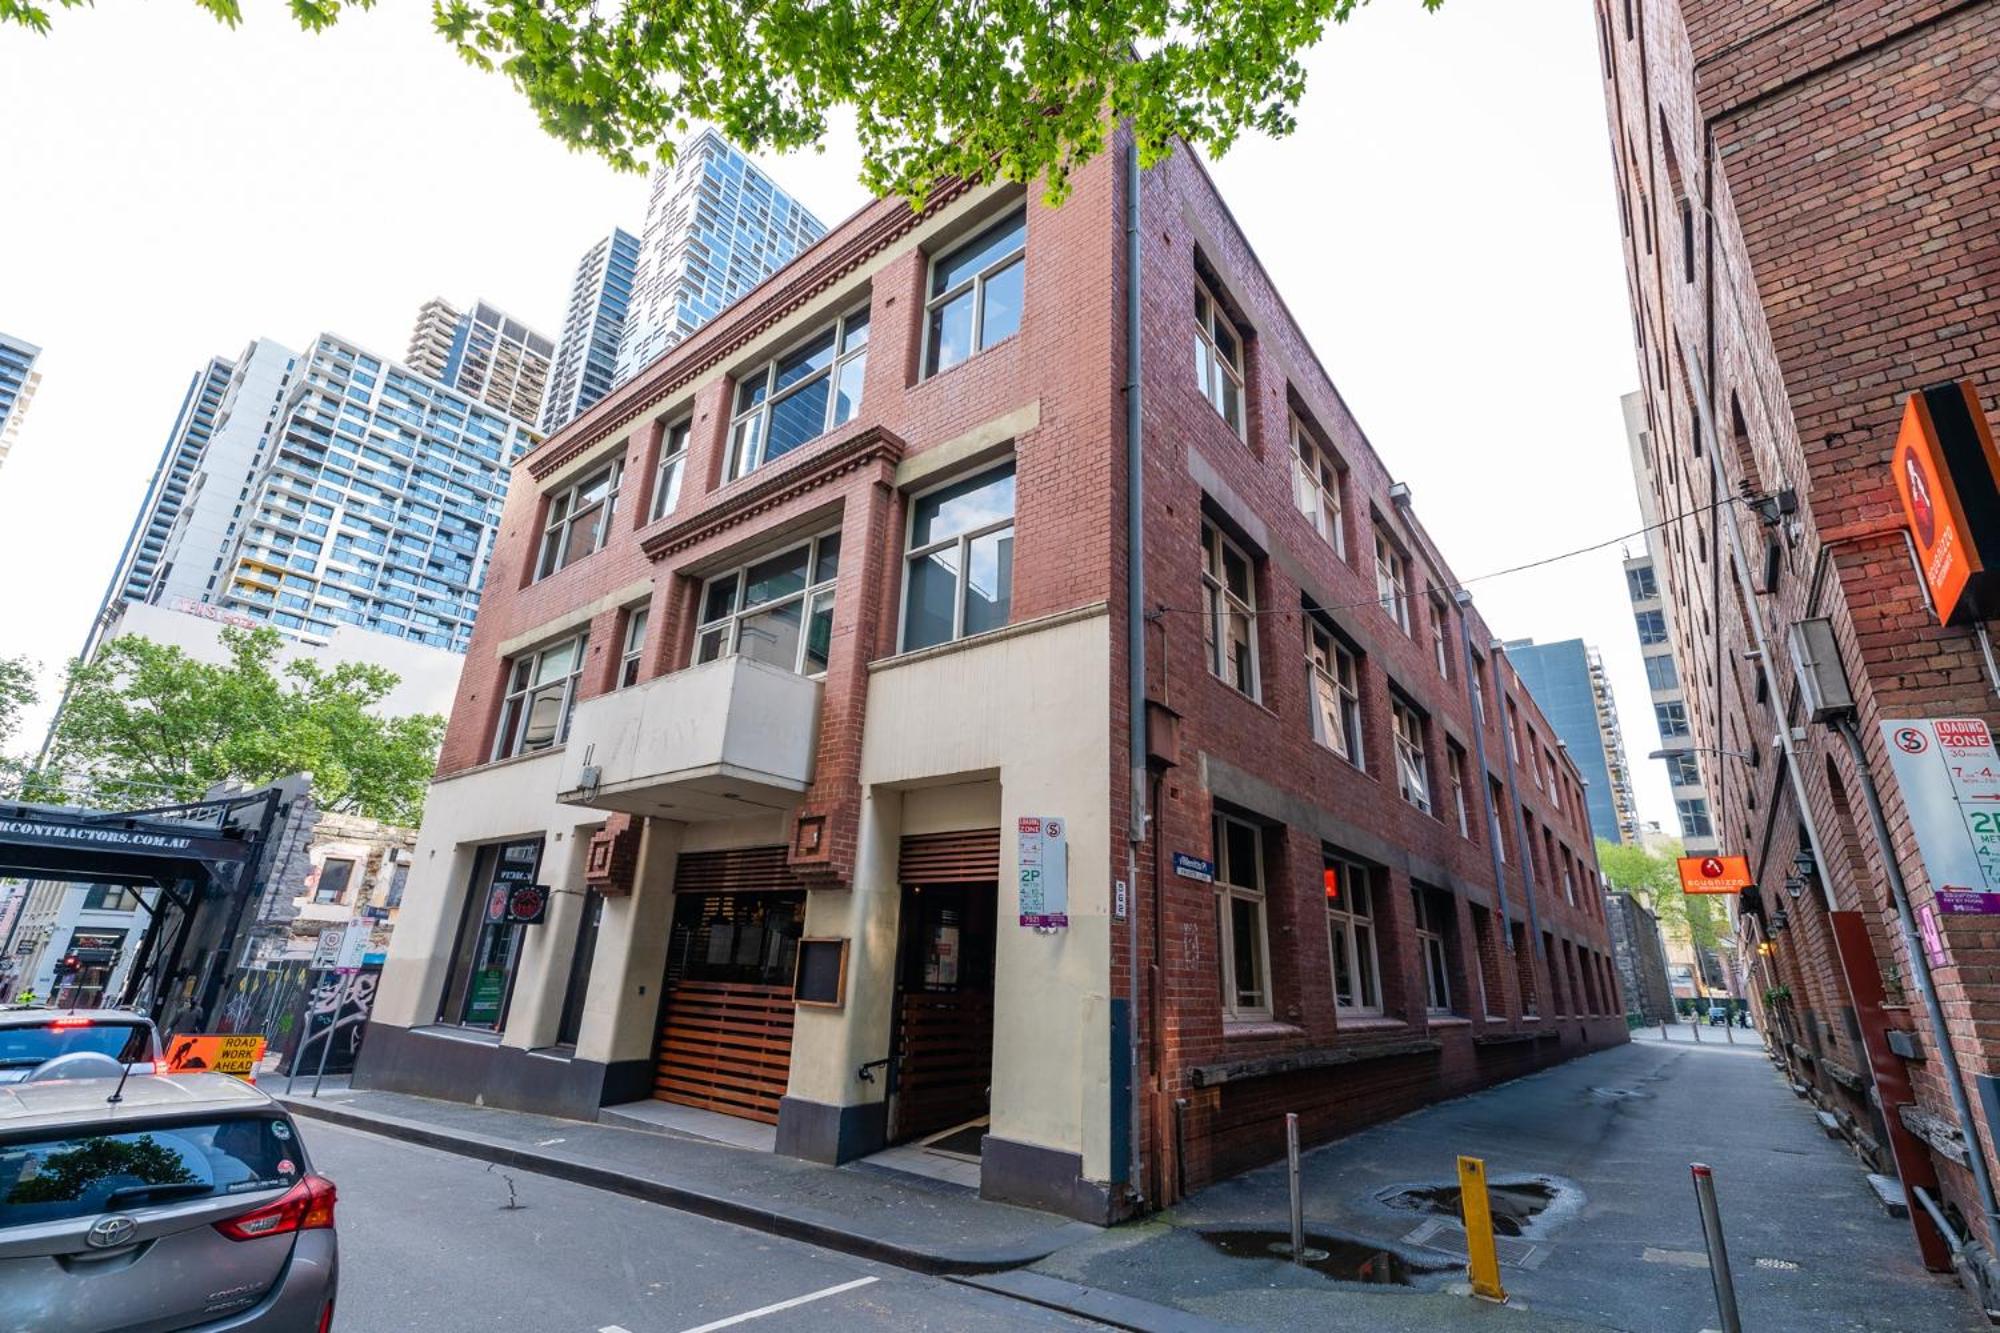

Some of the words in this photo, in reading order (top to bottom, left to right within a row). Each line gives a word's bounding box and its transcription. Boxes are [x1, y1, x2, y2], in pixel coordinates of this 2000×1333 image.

[1936, 721, 1984, 733] LOADING
[1940, 735, 1990, 747] ZONE
[1021, 869, 1041, 882] 2P
[226, 1038, 257, 1047] ROAD
[221, 1049, 252, 1058] WORK
[213, 1061, 253, 1070] AHEAD
